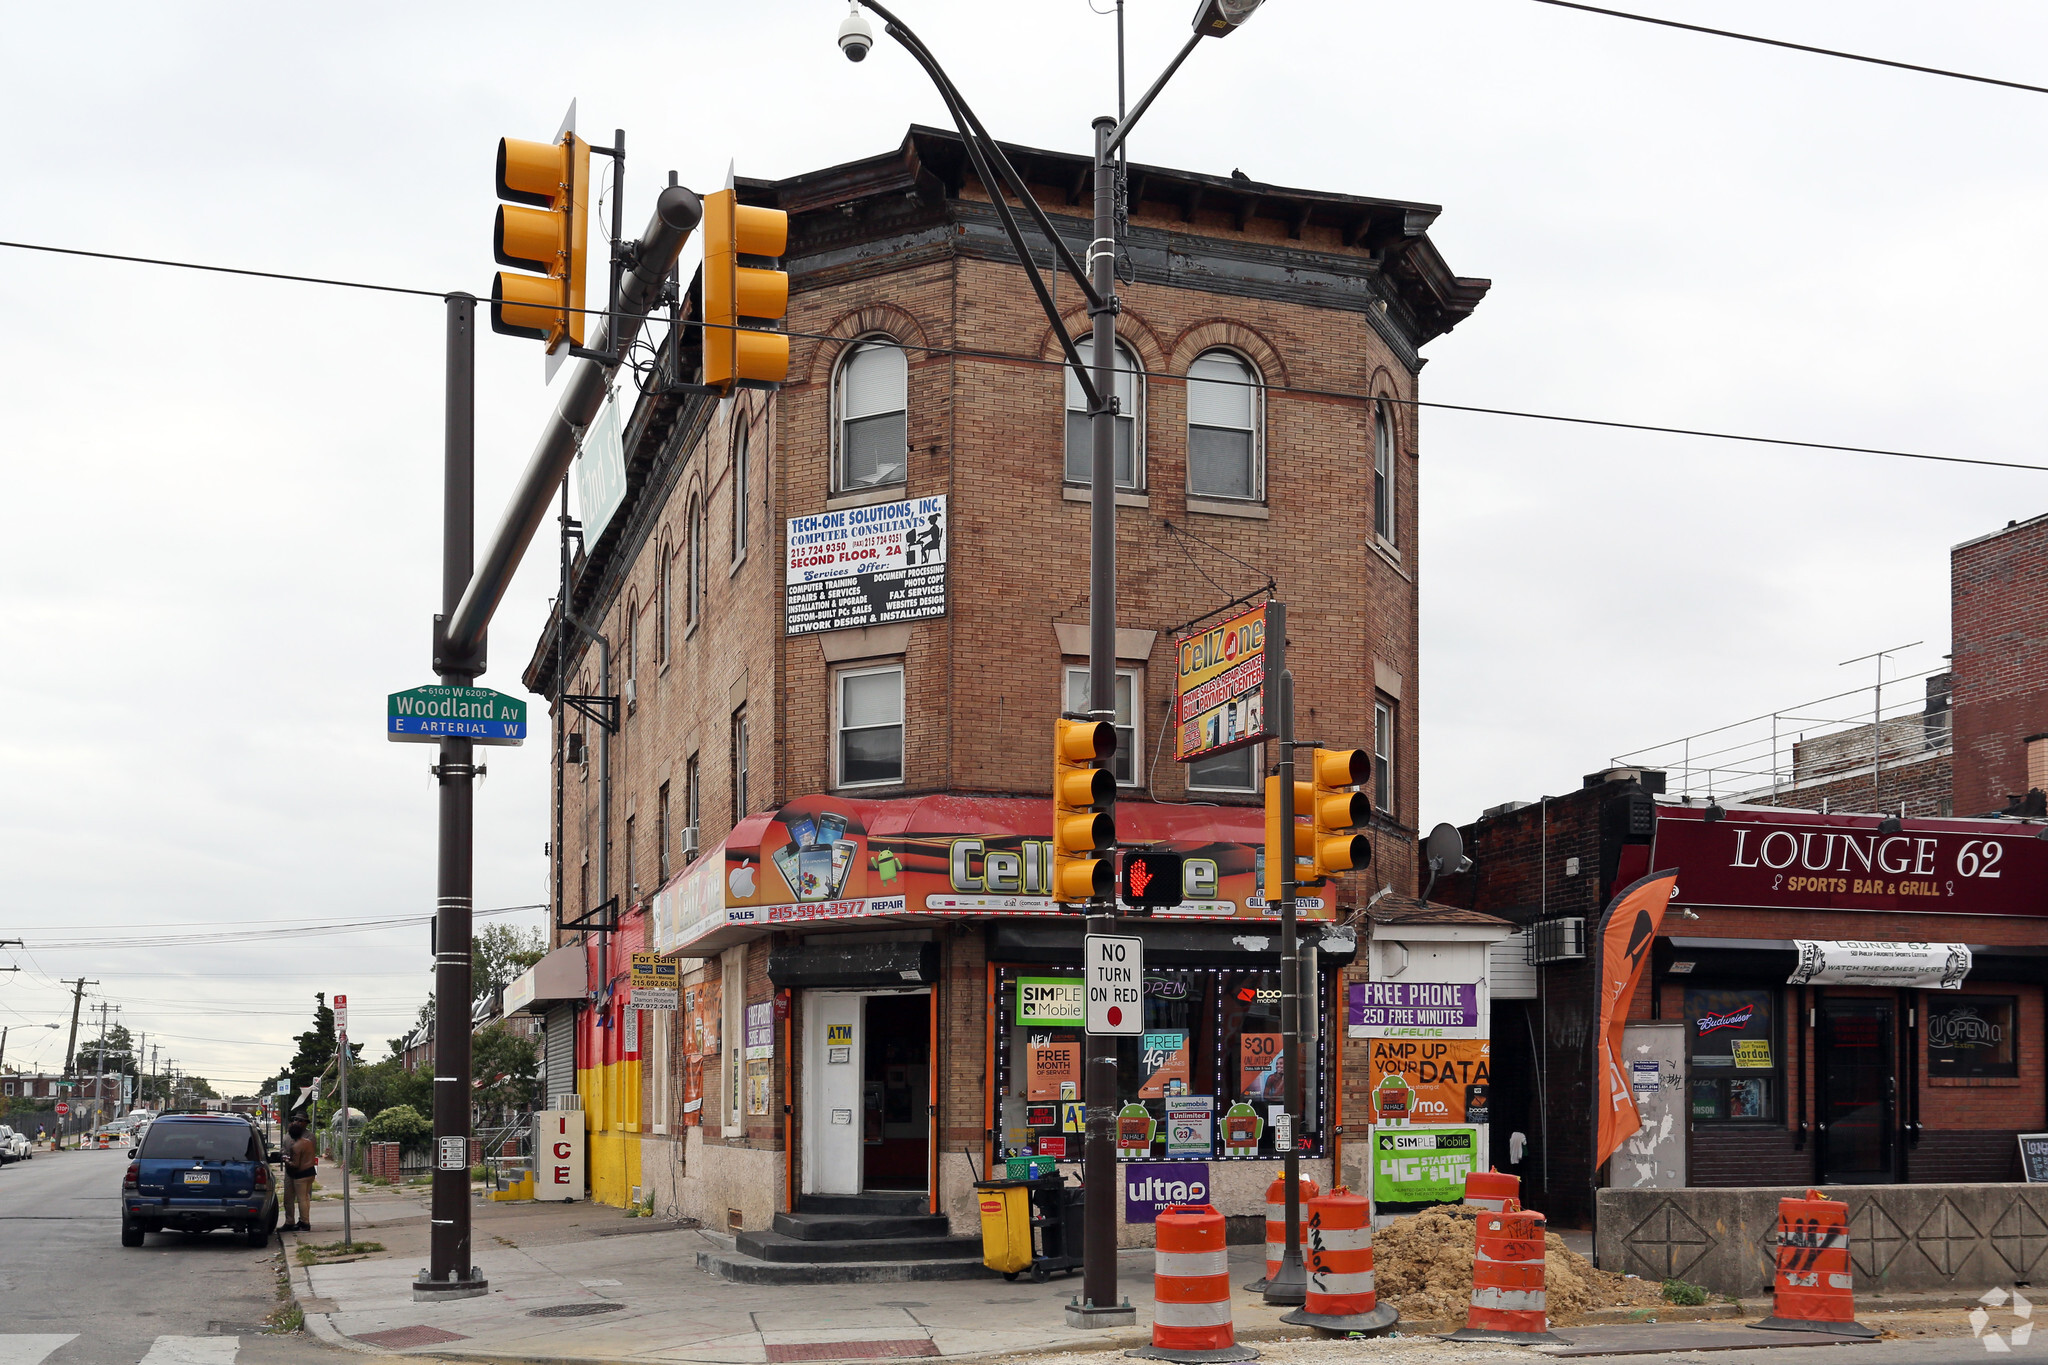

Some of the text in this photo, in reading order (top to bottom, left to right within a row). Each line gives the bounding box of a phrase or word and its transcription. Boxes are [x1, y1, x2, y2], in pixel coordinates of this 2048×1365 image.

[792, 498, 942, 533] TECH-ONE SOLUTIONS, INC.
[791, 516, 925, 546] COMPUTER CONSULTANTS
[791, 547, 806, 557] 215
[808, 545, 823, 556] 724
[826, 542, 846, 552] 9350
[865, 537, 875, 547] 215
[876, 535, 887, 545] 724
[888, 533, 902, 544] 9351
[790, 545, 902, 568] SECOND FLOOR, 2A
[804, 562, 890, 581] Services Offer:
[873, 564, 944, 582] DOCUMENT PROCESSING
[789, 577, 858, 595] COMPUTER TRAINING
[904, 574, 944, 588] PHOTO COPY
[789, 592, 817, 604] REPAIRS
[828, 586, 861, 598] SERVICES
[889, 585, 944, 600] FAX SERVICES
[789, 600, 829, 613] INSTALLATION
[838, 595, 867, 606] UPGRADE
[886, 595, 944, 610] WEBSITES DESIGN
[788, 604, 872, 624] CUSTOM-BUILT PCs SALES
[788, 606, 944, 633] NETWORK DESIGN & INSTALLATION
[1183, 688, 1199, 703] PHONE
[1200, 680, 1216, 696] SALES
[1221, 668, 1239, 686] REPAIR
[1239, 656, 1262, 678] SERVICE
[428, 687, 487, 698] 6100 W 6200
[1183, 667, 1262, 719] BILL PAYMENT CENTER
[396, 696, 494, 719] Woodland
[396, 719, 519, 736] E ARTERIAL W
[1729, 829, 2004, 878] LOUNGE 62
[1787, 877, 1940, 896] SPORTS BAR & GRILL
[768, 901, 865, 920] 215-594-3577
[871, 899, 904, 910] REPAIR
[1249, 898, 1263, 907] BILL
[1296, 899, 1319, 907] CENTER
[729, 911, 754, 920] SALES
[632, 954, 676, 964] For Sale
[1102, 943, 1126, 962] NO
[1098, 967, 1131, 982] TURN
[1023, 987, 1081, 1001] SIMPLE
[1090, 987, 1138, 1002] ON RED
[1364, 984, 1462, 1006] FREE PHONE
[1038, 1003, 1081, 1016] Mobile
[1363, 1009, 1464, 1025] 250 FREE MINUTES
[1697, 1014, 1752, 1031] Budweiser
[1947, 1021, 1985, 1038] OPEN
[828, 1027, 851, 1039] ATM
[1389, 1028, 1443, 1036] LIFELINE
[1031, 1033, 1052, 1050] NEW
[1145, 1035, 1181, 1049] FREE
[1244, 1037, 1274, 1055] $30
[1036, 1050, 1070, 1061] FREE
[1374, 1043, 1448, 1059] AMP UP
[1734, 1049, 1770, 1058] Gordon
[1143, 1047, 1178, 1075] 4G LTE
[1375, 1060, 1490, 1084] YOUR DATA
[1171, 1099, 1208, 1108] Lycamobile
[1029, 1116, 1053, 1124] WANTED
[1397, 1135, 1469, 1148] SIMPLE Mobile
[553, 1115, 571, 1186] ICE
[1421, 1154, 1470, 1165] STARTING
[1380, 1157, 1421, 1182] 4G
[1429, 1163, 1472, 1185] $40
[1129, 1176, 1188, 1202] ultra
